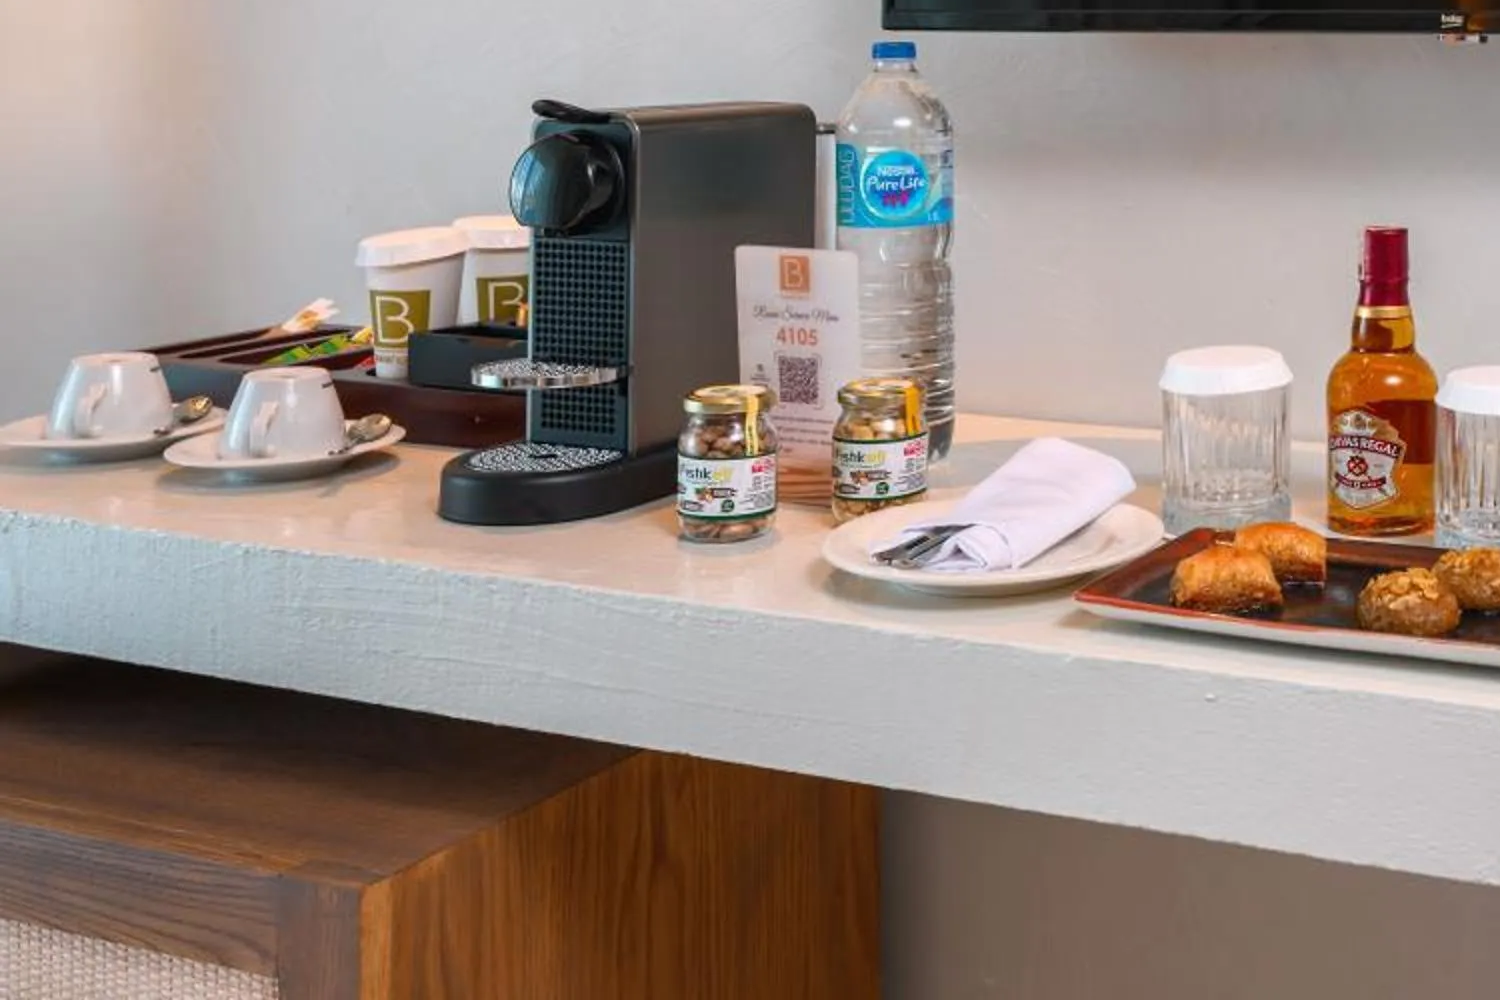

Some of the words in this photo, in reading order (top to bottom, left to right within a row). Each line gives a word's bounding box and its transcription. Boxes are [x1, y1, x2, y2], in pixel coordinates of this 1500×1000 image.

[783, 258, 803, 288] B
[375, 295, 415, 343] B
[776, 326, 818, 347] 4105
[1360, 438, 1398, 457] REGAL
